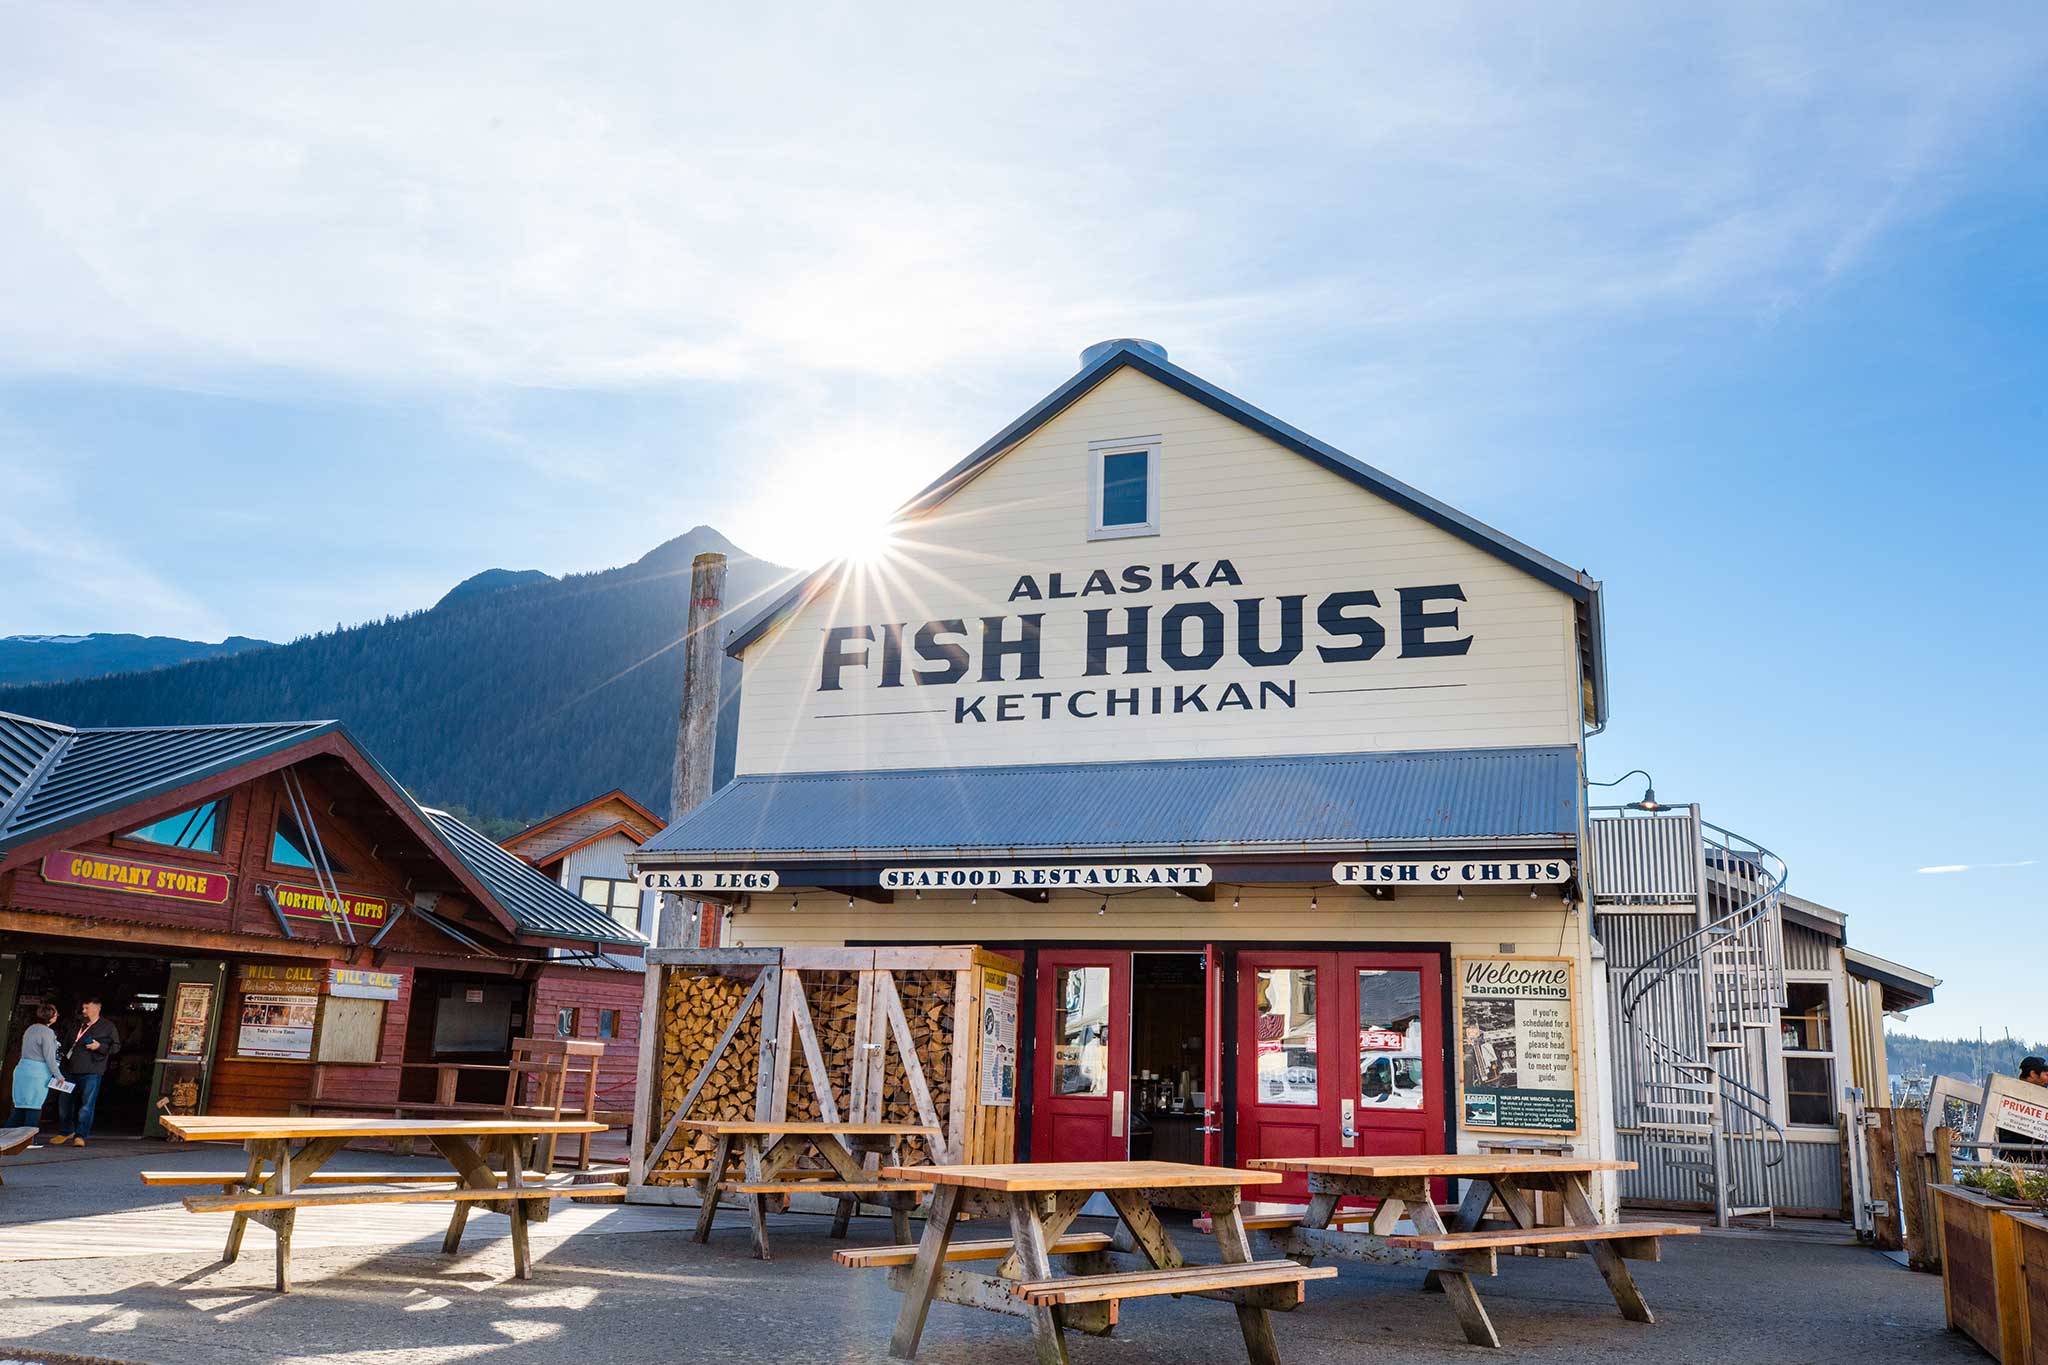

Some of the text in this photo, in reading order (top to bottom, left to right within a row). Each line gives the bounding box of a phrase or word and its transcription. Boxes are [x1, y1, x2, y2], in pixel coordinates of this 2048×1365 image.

[1008, 559, 1243, 601] ALASKA
[816, 583, 1474, 691] FISH HOUSE
[953, 679, 1296, 724] KETCHIKAN
[70, 859, 208, 894] COMPANY STORE
[644, 873, 772, 888] CRAB LEGS
[886, 867, 1203, 887] SEAFOOD RESTAURANT
[1342, 862, 1561, 882] FISH & CHIPS
[354, 902, 383, 919] GIFTS
[248, 965, 314, 980] WILL CALL
[337, 969, 393, 987] WILL CALL
[1465, 962, 1568, 984] Welcome
[1471, 985, 1520, 994] Baranof
[1521, 985, 1567, 997] Fishing
[1532, 1008, 1559, 1018] If you're
[1522, 1019, 1553, 1027] scheduled
[1528, 1030, 1549, 1040] fishing
[1528, 1041, 1565, 1049] please head
[1525, 1051, 1541, 1059] down
[1553, 1053, 1570, 1062] ramp
[1528, 1062, 1535, 1070] to
[1553, 1064, 1567, 1072] your
[2002, 1099, 2043, 1118] PRIVATE
